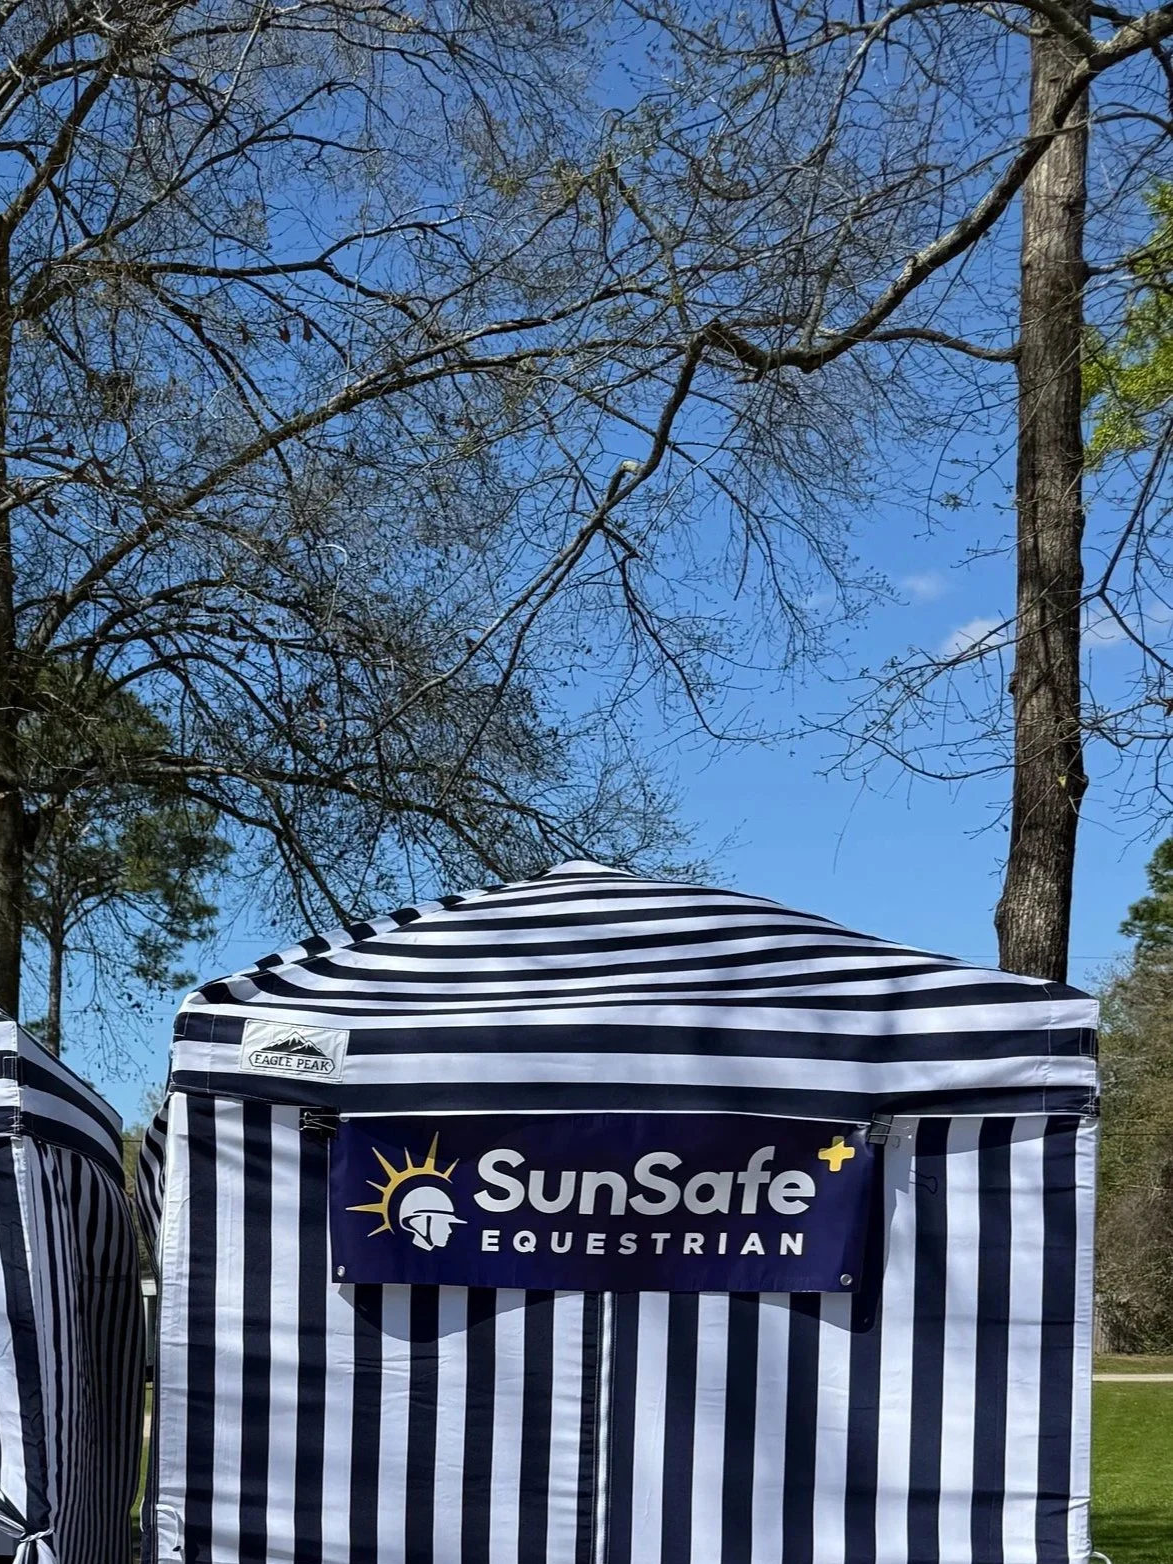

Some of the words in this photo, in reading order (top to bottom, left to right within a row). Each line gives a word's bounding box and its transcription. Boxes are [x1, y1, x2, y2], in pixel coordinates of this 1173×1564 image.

[254, 1054, 293, 1067] EAGLE
[296, 1058, 330, 1072] PEAK
[482, 1230, 804, 1256] EQUESTRIAN
